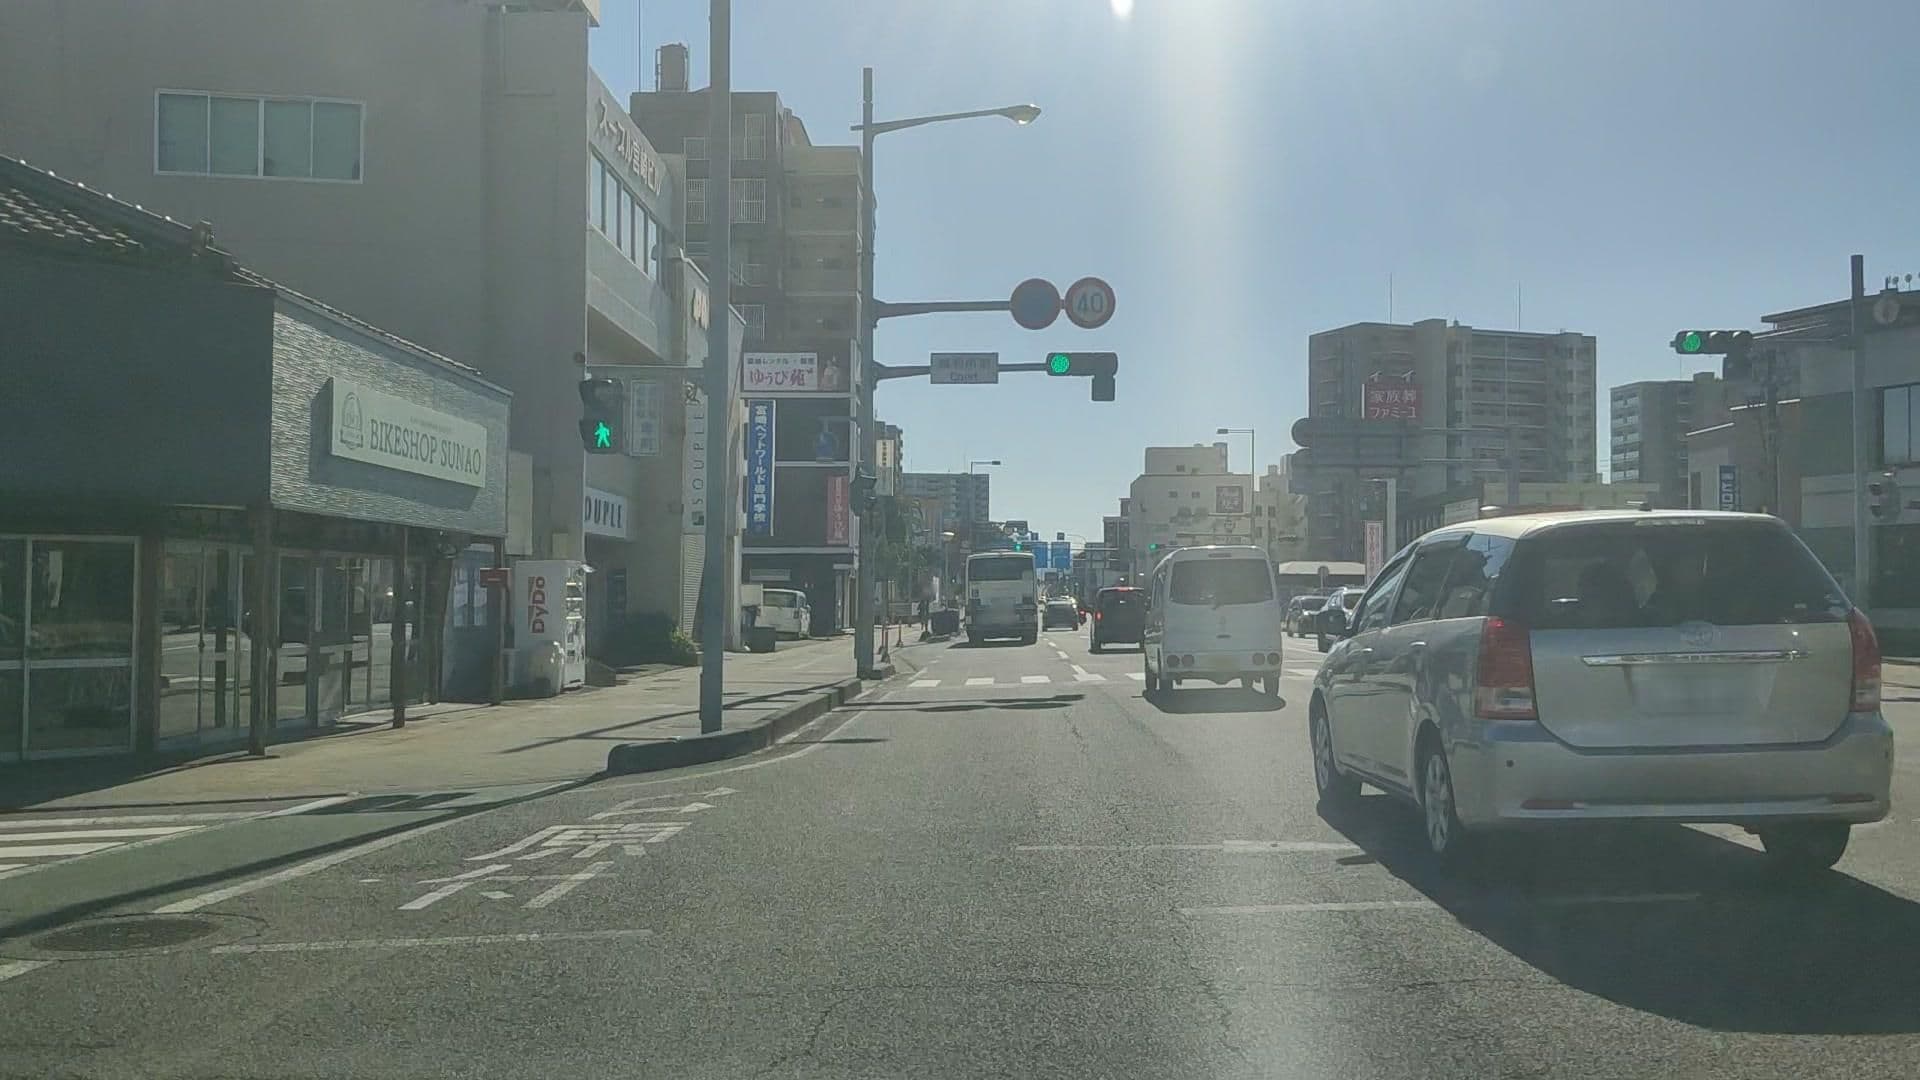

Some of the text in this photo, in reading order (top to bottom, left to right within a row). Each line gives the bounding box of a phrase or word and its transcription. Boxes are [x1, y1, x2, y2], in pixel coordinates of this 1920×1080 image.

[1077, 292, 1104, 314] 40
[370, 418, 438, 464] BIKESHOP
[440, 439, 481, 475] SUNAO
